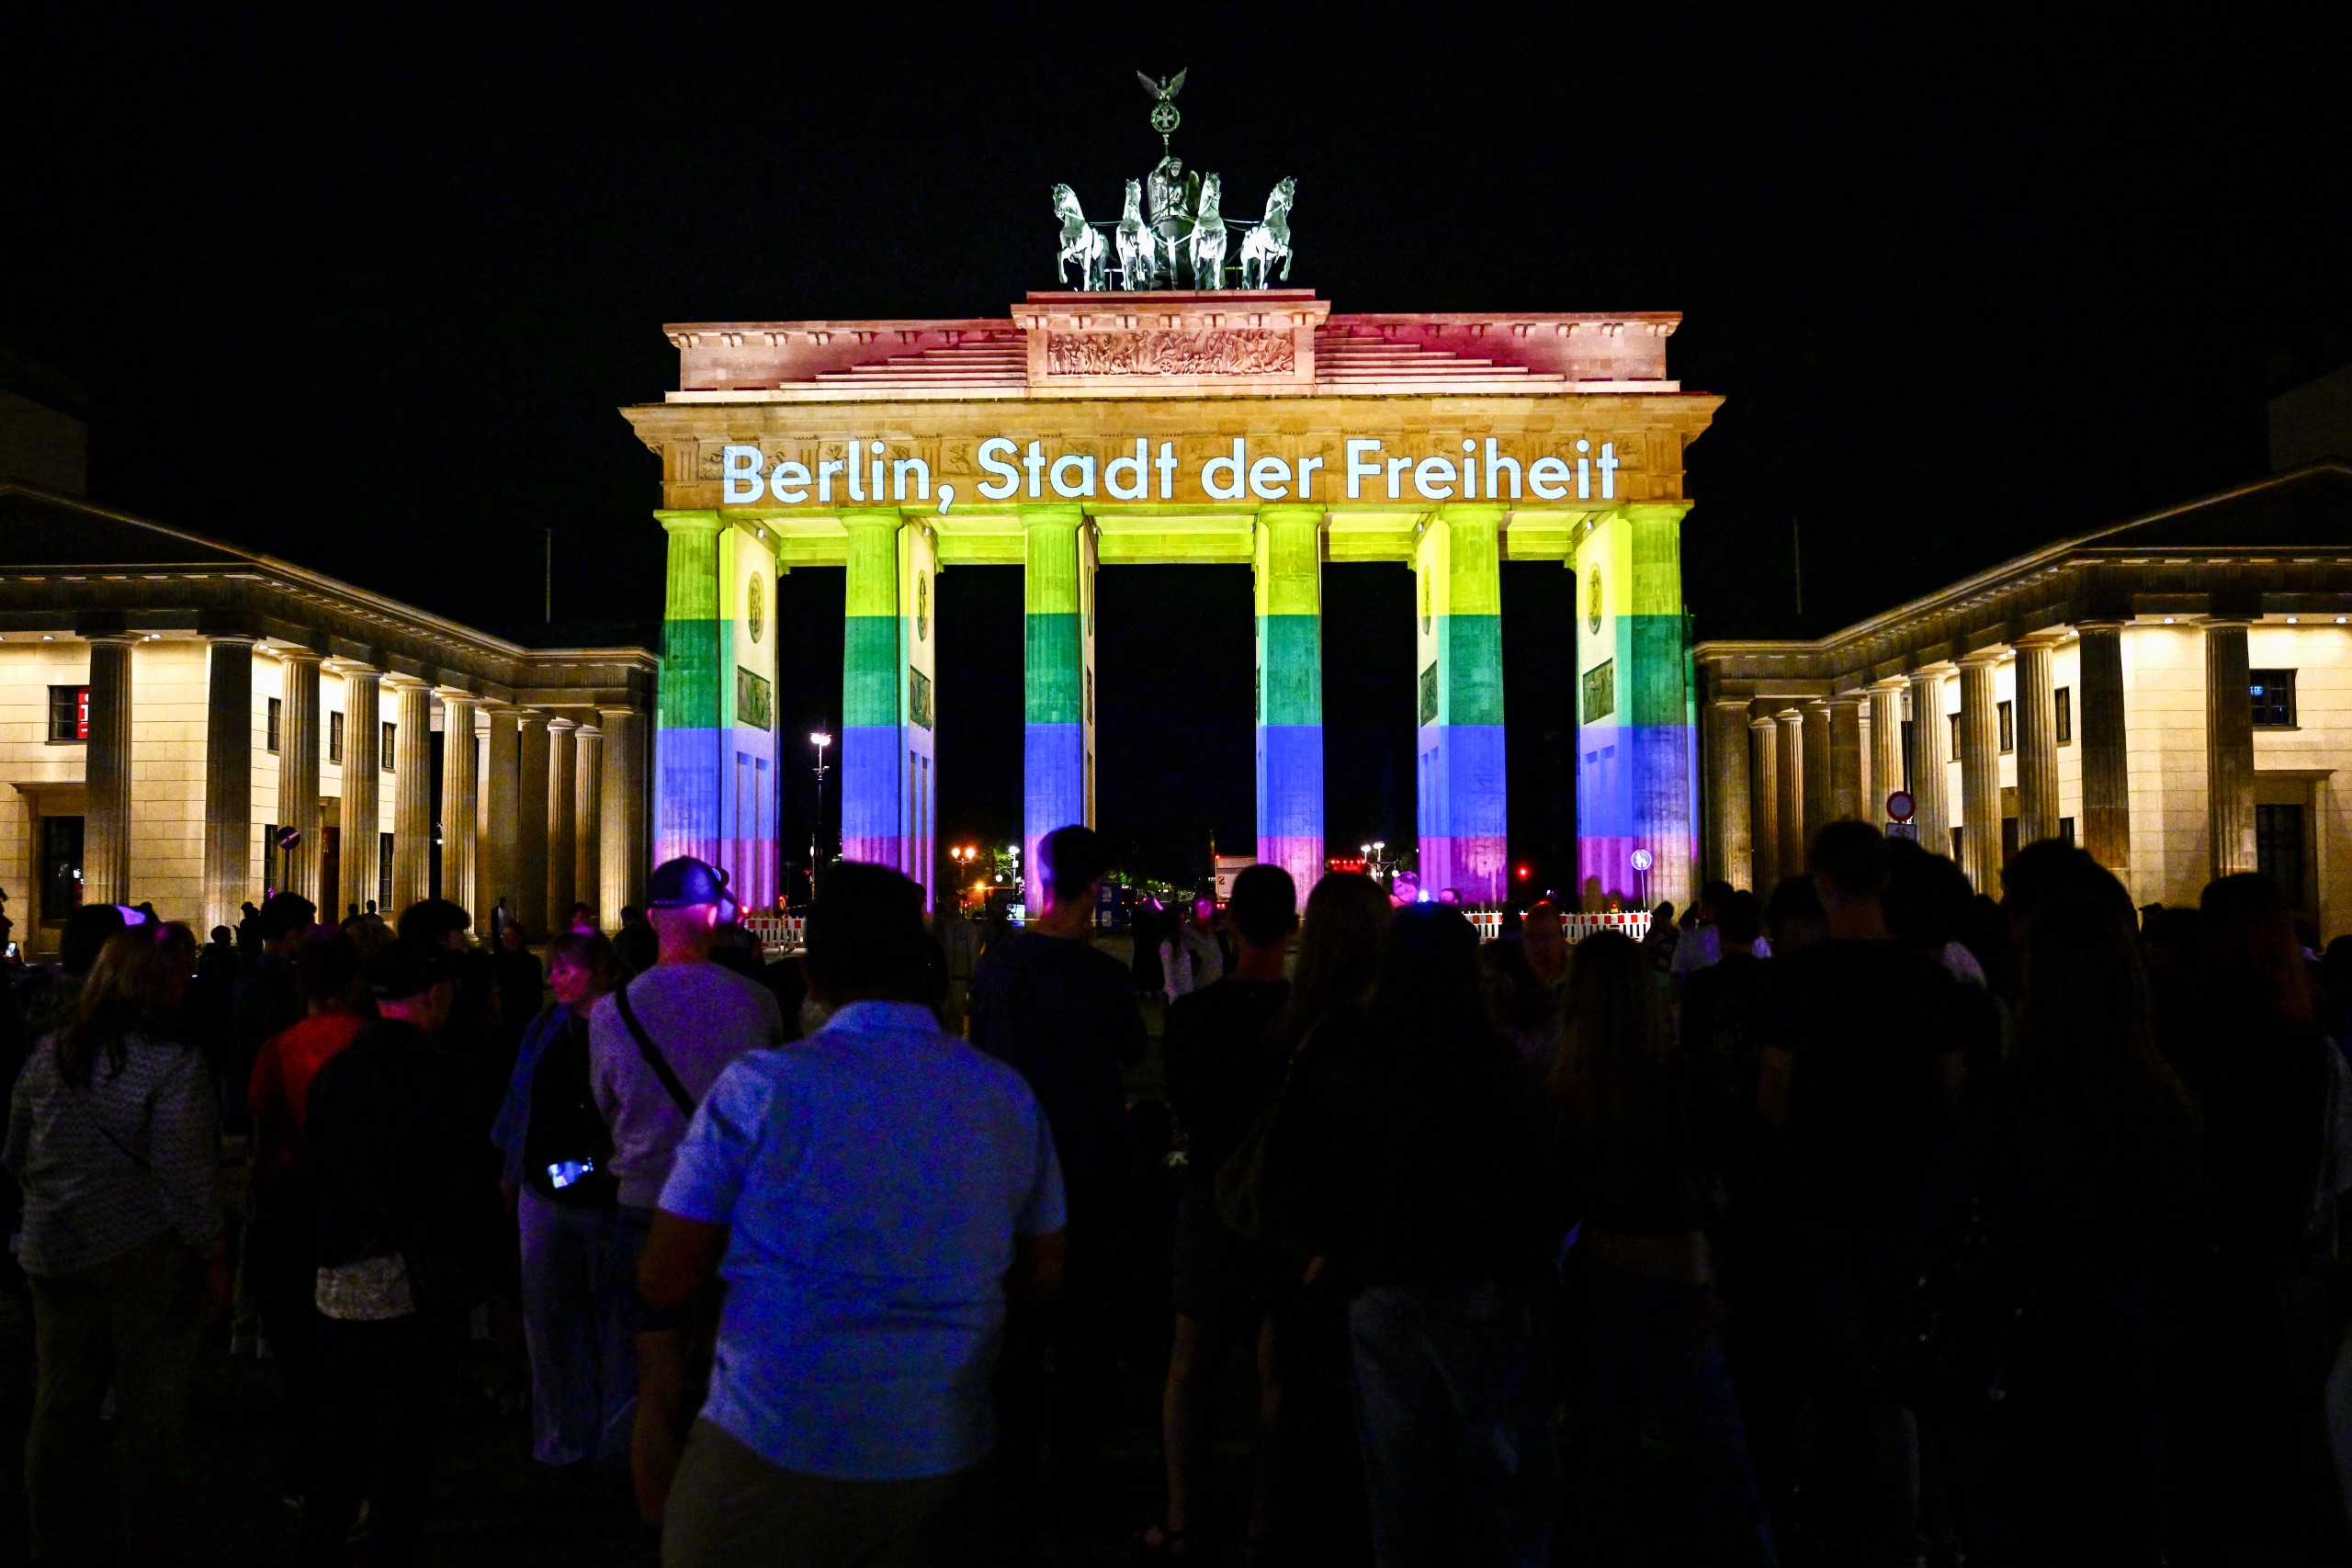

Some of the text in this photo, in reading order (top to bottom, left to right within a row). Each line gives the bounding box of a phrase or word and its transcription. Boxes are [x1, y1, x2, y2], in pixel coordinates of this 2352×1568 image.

[723, 437, 1619, 514] Berlin, Stadt der Freiheit
